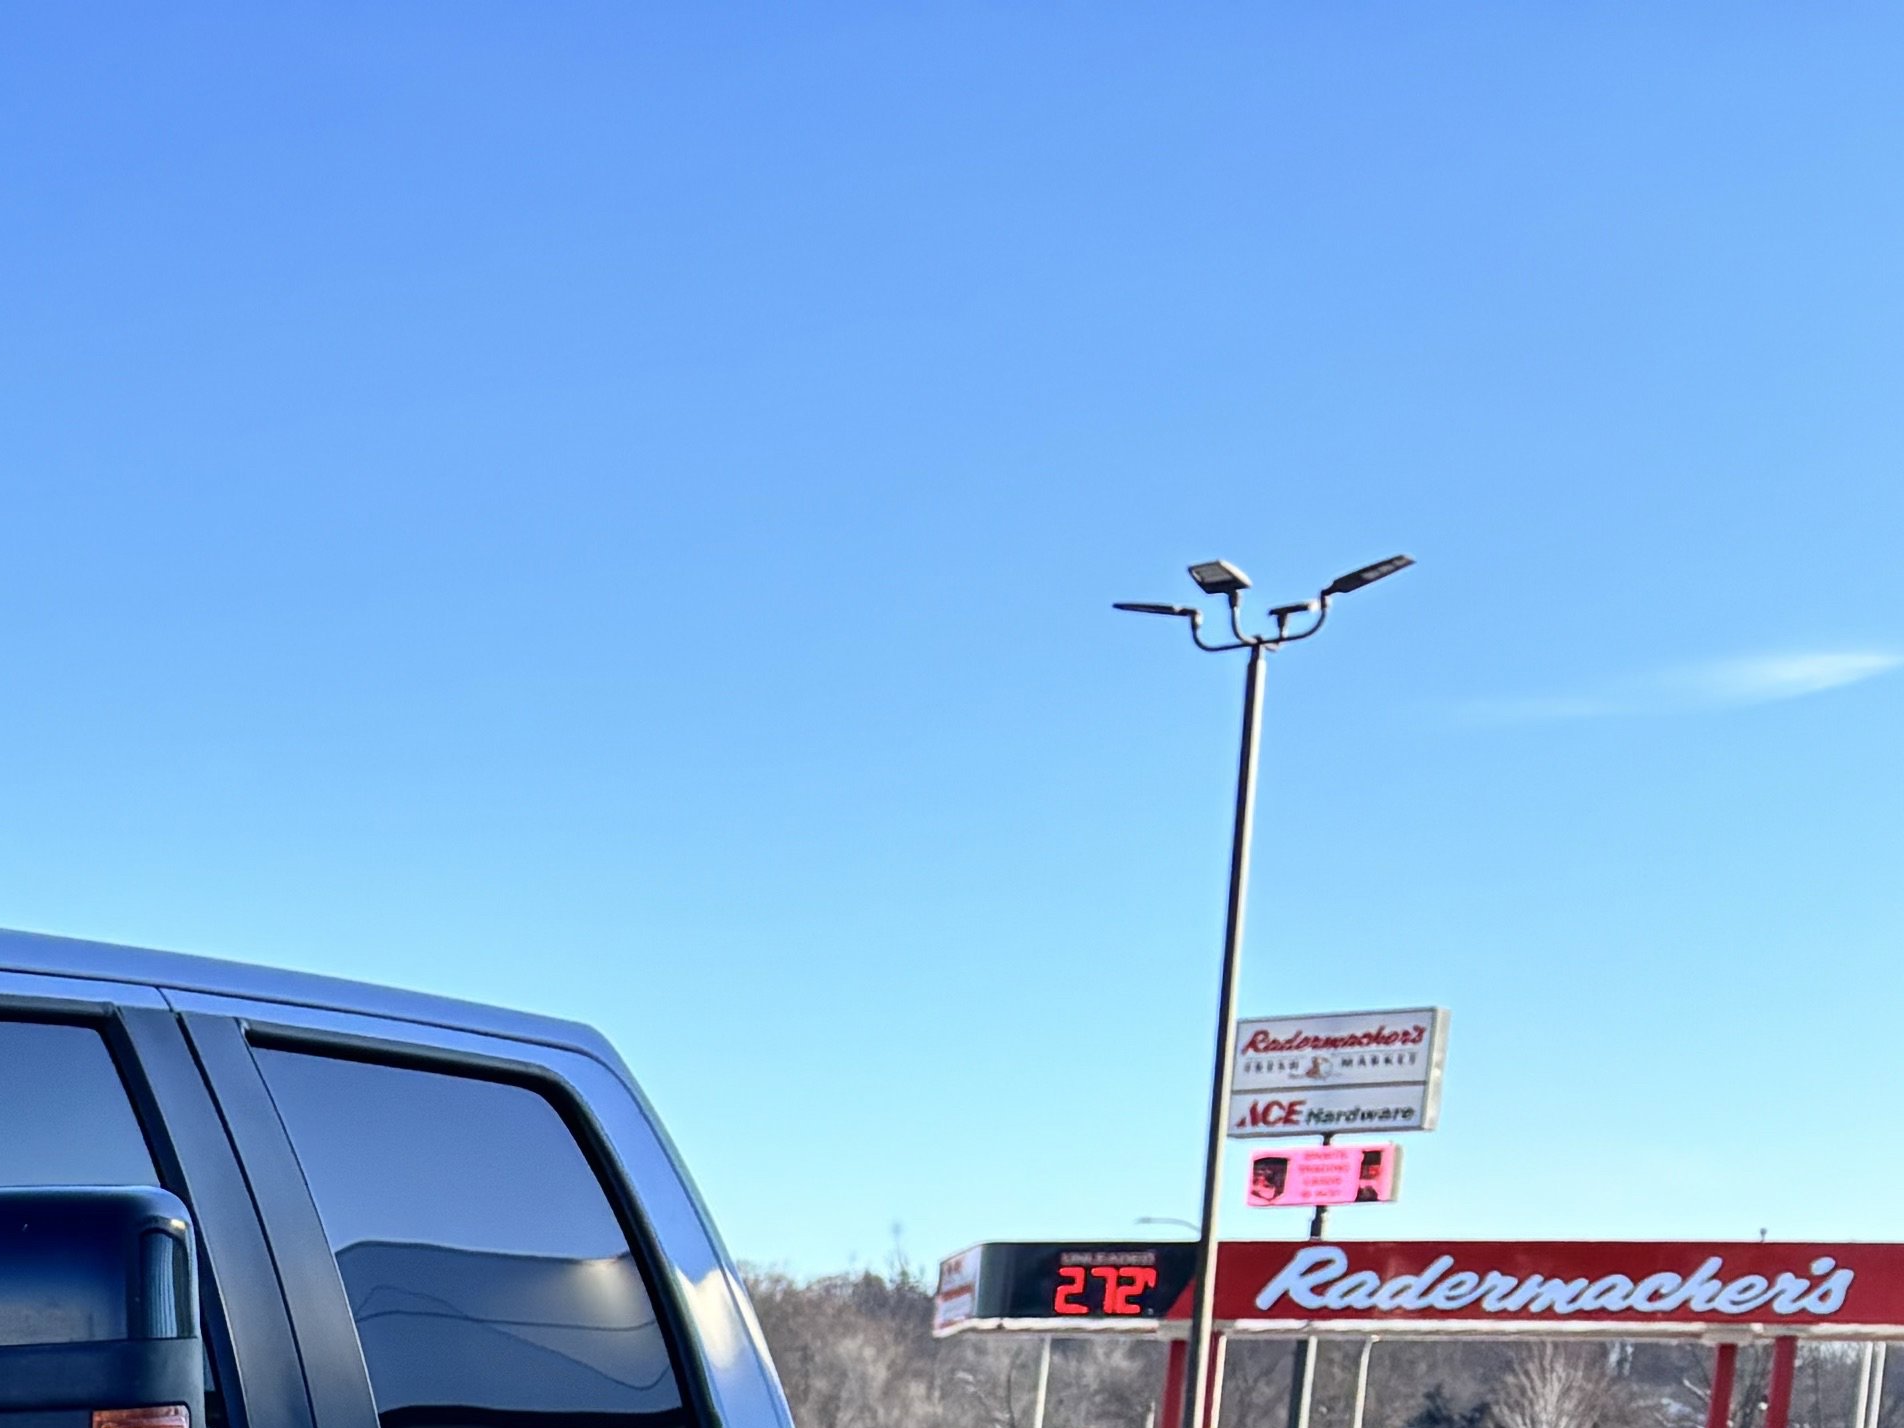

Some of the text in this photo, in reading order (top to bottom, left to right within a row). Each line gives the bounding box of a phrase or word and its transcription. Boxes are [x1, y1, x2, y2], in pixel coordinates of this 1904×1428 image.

[1236, 1100, 1415, 1128] ACE Hardware
[1255, 1246, 1855, 1315] Radermacher's
